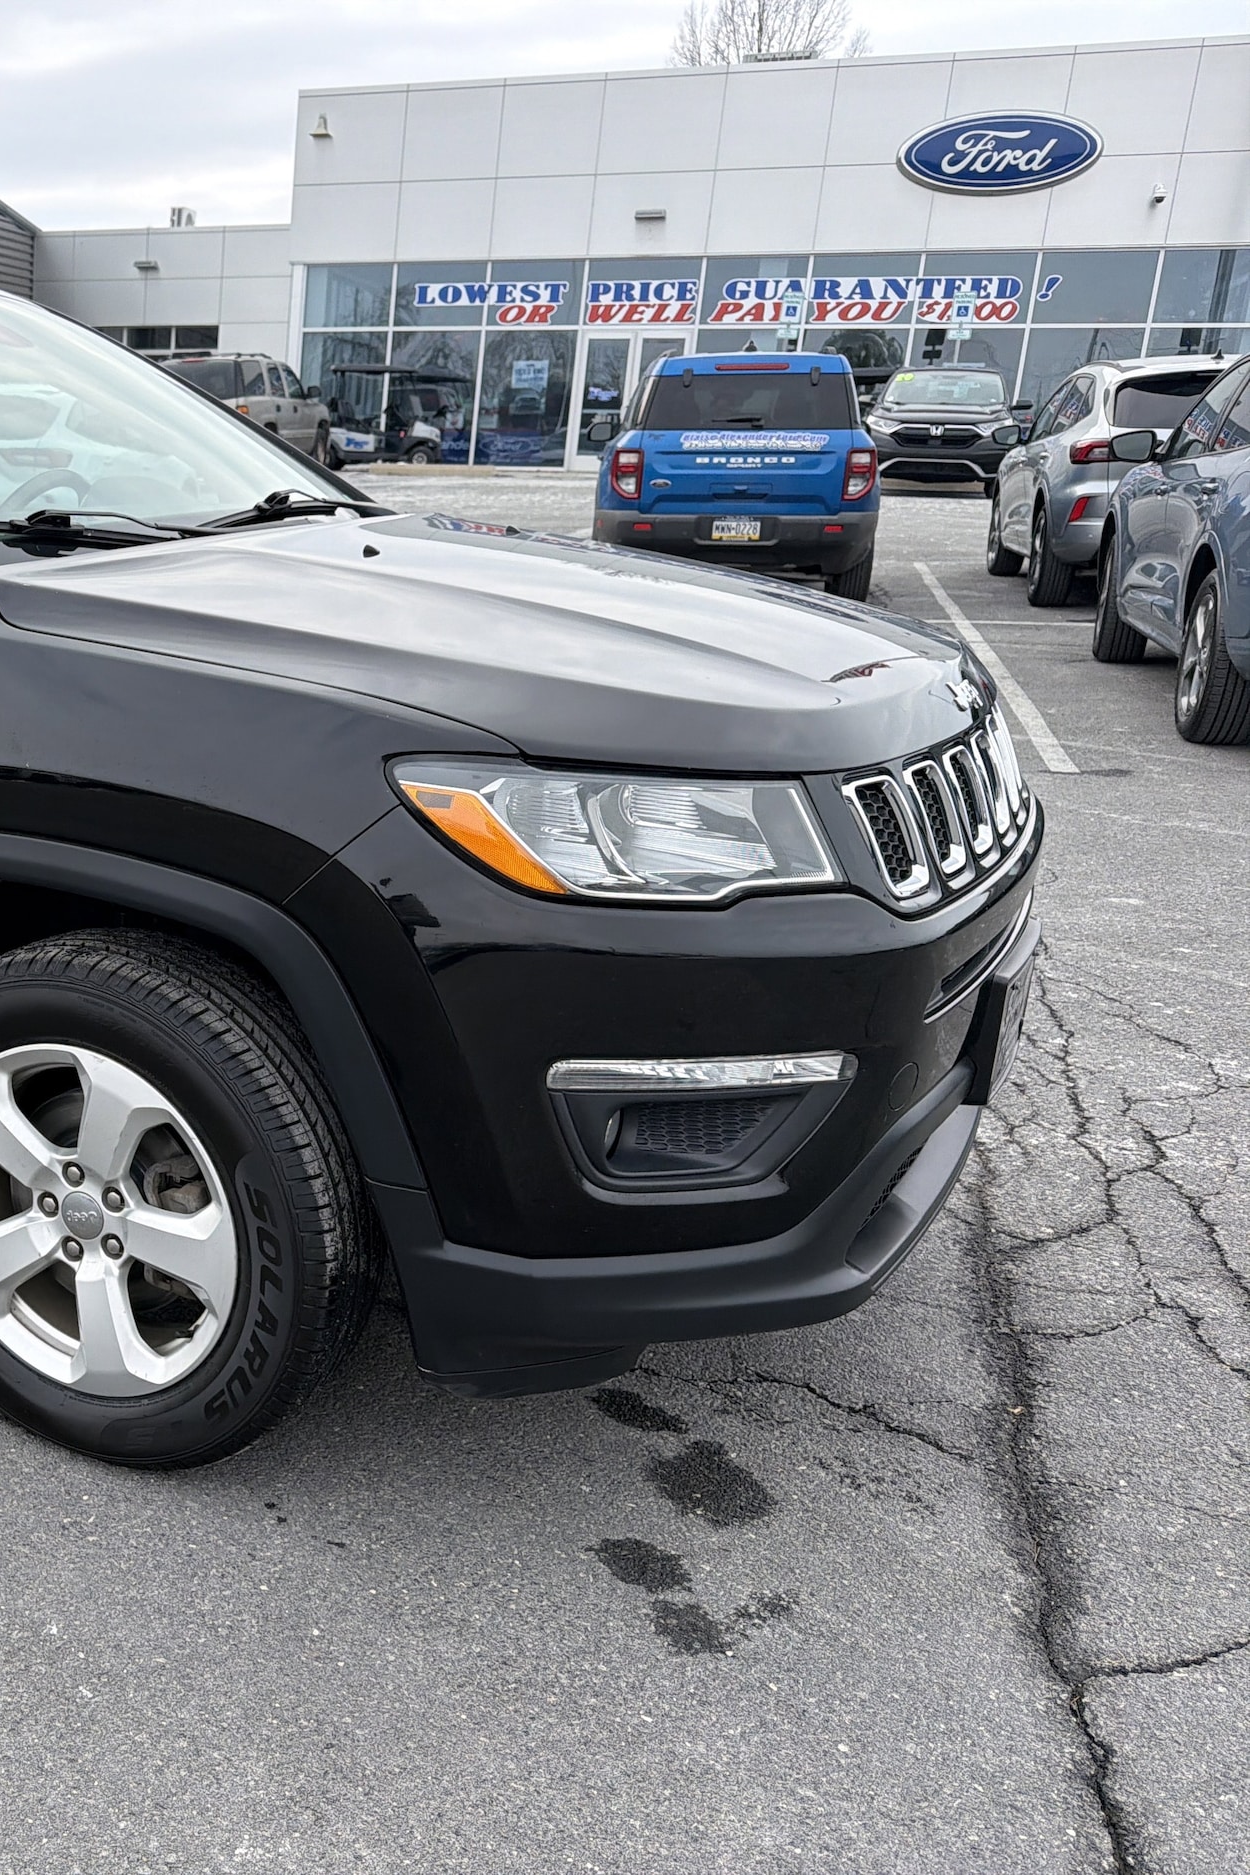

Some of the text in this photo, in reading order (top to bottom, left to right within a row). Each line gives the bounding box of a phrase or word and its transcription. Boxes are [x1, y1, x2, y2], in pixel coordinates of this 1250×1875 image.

[940, 130, 1058, 174] Ford
[416, 283, 567, 304] LOWEST
[588, 281, 697, 302] PRICE
[725, 278, 1021, 300] GUARANTEED
[499, 304, 555, 323] OR
[811, 301, 906, 322] YOU
[918, 300, 1018, 321] $1,00
[696, 456, 795, 464] BRONCO
[203, 1181, 283, 1426] SOLARUS
